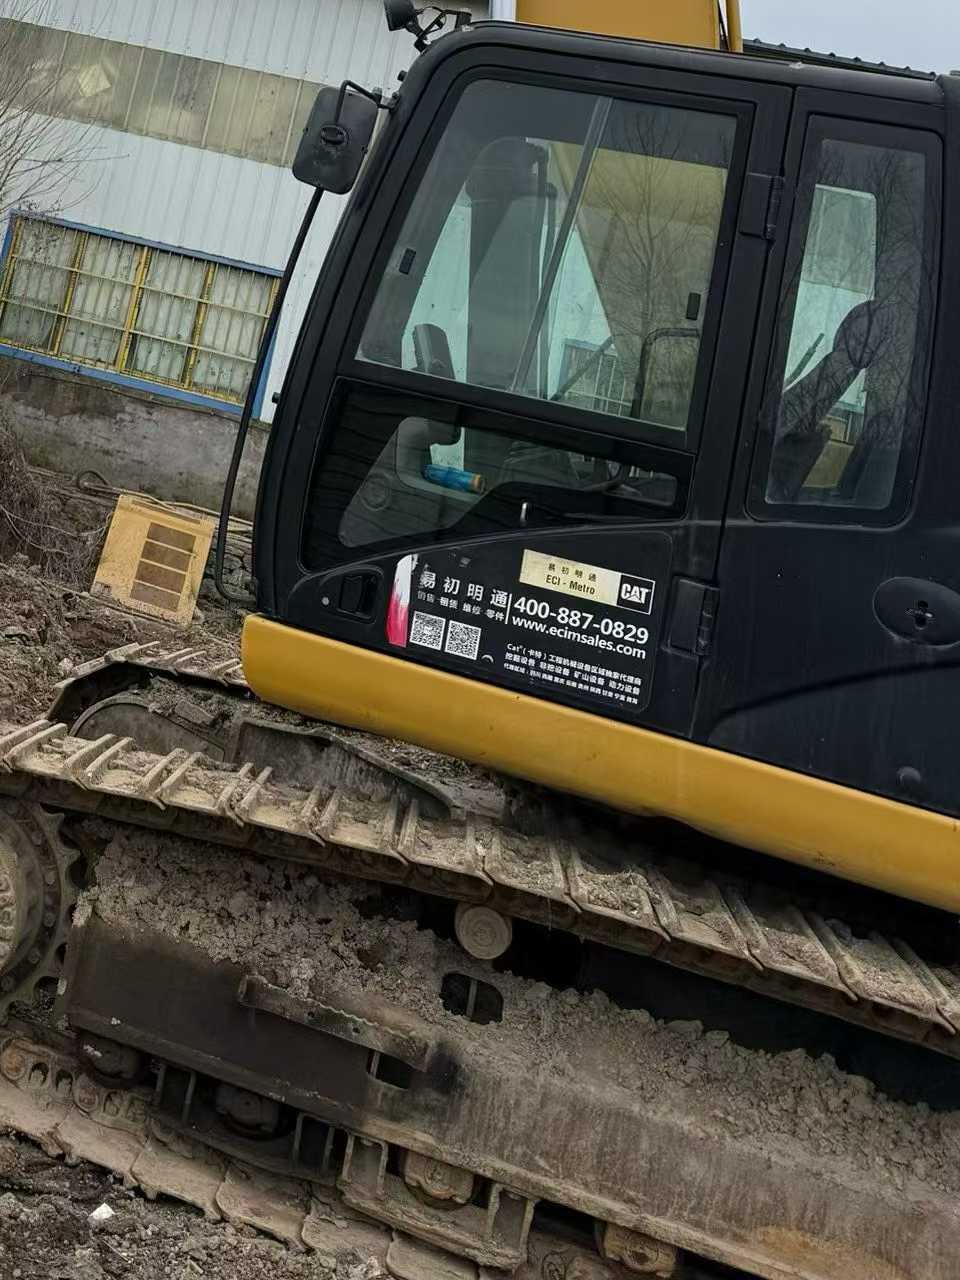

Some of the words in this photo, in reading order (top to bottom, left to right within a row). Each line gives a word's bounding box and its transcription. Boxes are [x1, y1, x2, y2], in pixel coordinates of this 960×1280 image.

[419, 570, 507, 608] 易初明通
[545, 574, 560, 586] ECI
[569, 580, 596, 595] Metro
[620, 583, 650, 604] CAT
[511, 616, 646, 660] www.ecimsales.com
[513, 596, 649, 645] 400-887-0829
